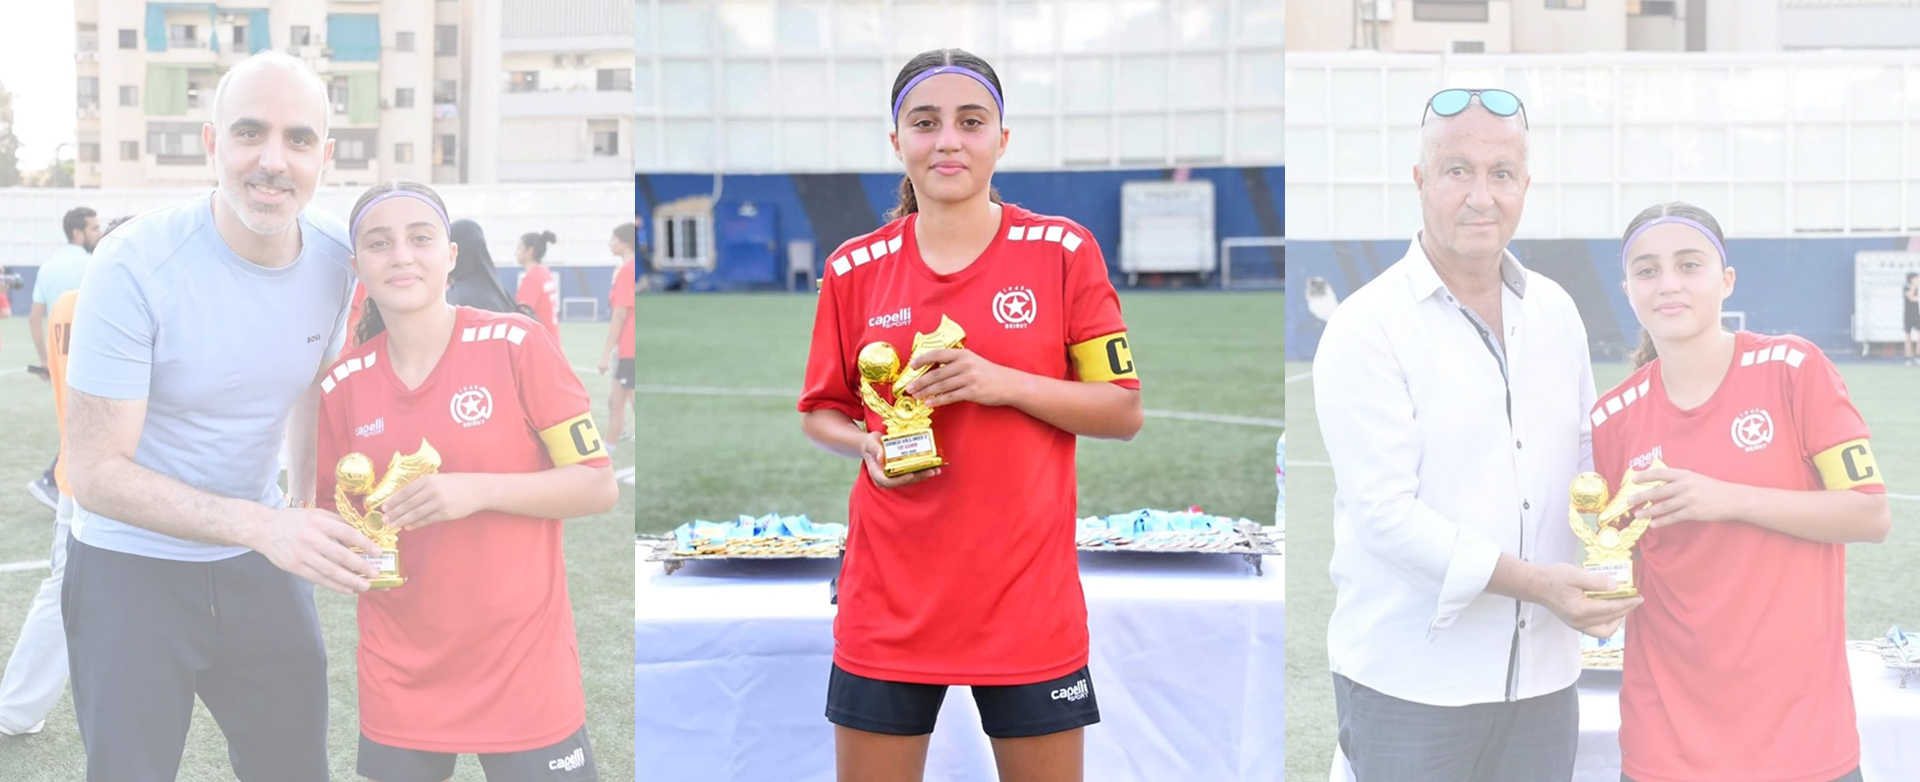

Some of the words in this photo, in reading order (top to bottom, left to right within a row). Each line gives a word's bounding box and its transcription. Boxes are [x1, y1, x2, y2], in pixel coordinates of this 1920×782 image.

[868, 306, 911, 327] capelli
[306, 333, 321, 344] BOSS
[1105, 336, 1134, 376] C
[569, 418, 601, 456] C
[1841, 444, 1874, 482] C
[1051, 678, 1088, 701] capelli
[548, 747, 585, 771] capelli
